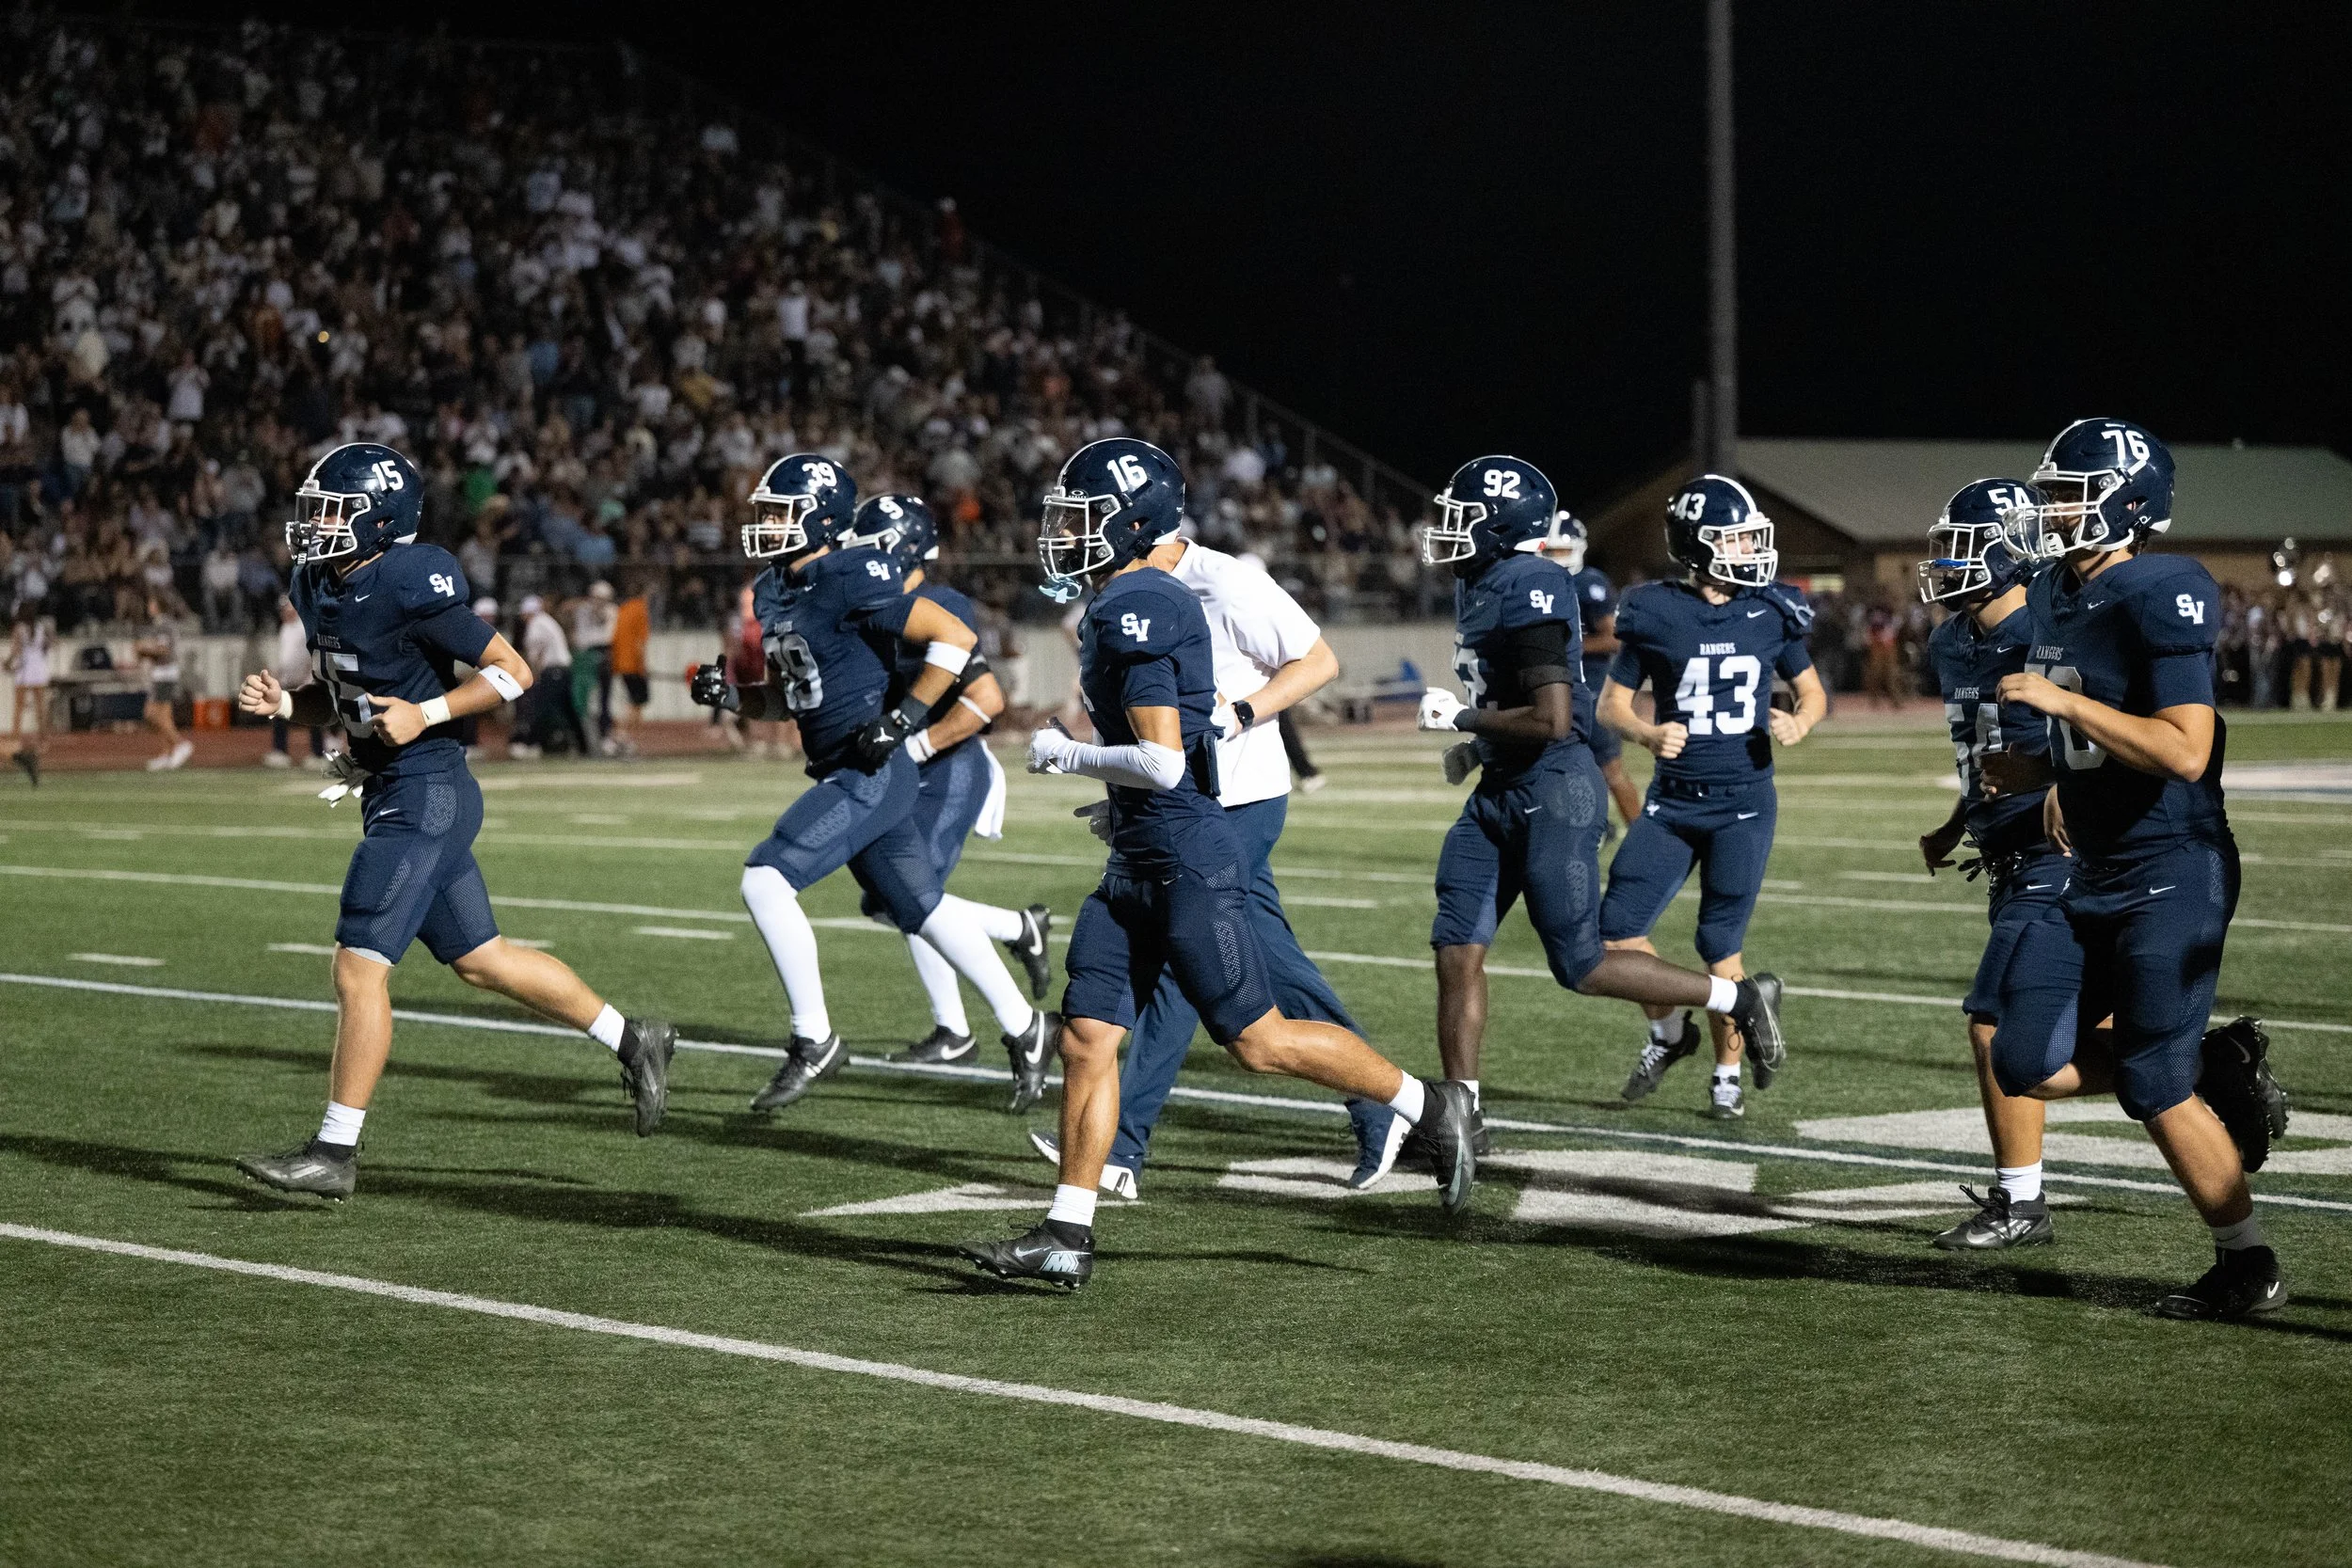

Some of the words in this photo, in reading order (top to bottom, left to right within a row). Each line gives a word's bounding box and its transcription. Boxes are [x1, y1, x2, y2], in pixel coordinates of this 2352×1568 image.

[2101, 430, 2150, 466] 76
[372, 460, 404, 491] 15
[802, 462, 837, 487] 39
[1106, 454, 1147, 492] 16
[1484, 469, 1521, 499] 92
[1675, 493, 1707, 520] 43
[865, 561, 891, 581] SV
[429, 573, 455, 597] SV
[1530, 590, 1554, 614] SV
[2176, 594, 2205, 625] SV
[1120, 612, 1151, 642] SV
[1700, 642, 1736, 656] RANGERS
[2035, 645, 2064, 660] RANGERS
[1676, 656, 1761, 735] 43
[1954, 687, 1979, 700] RANGERS
